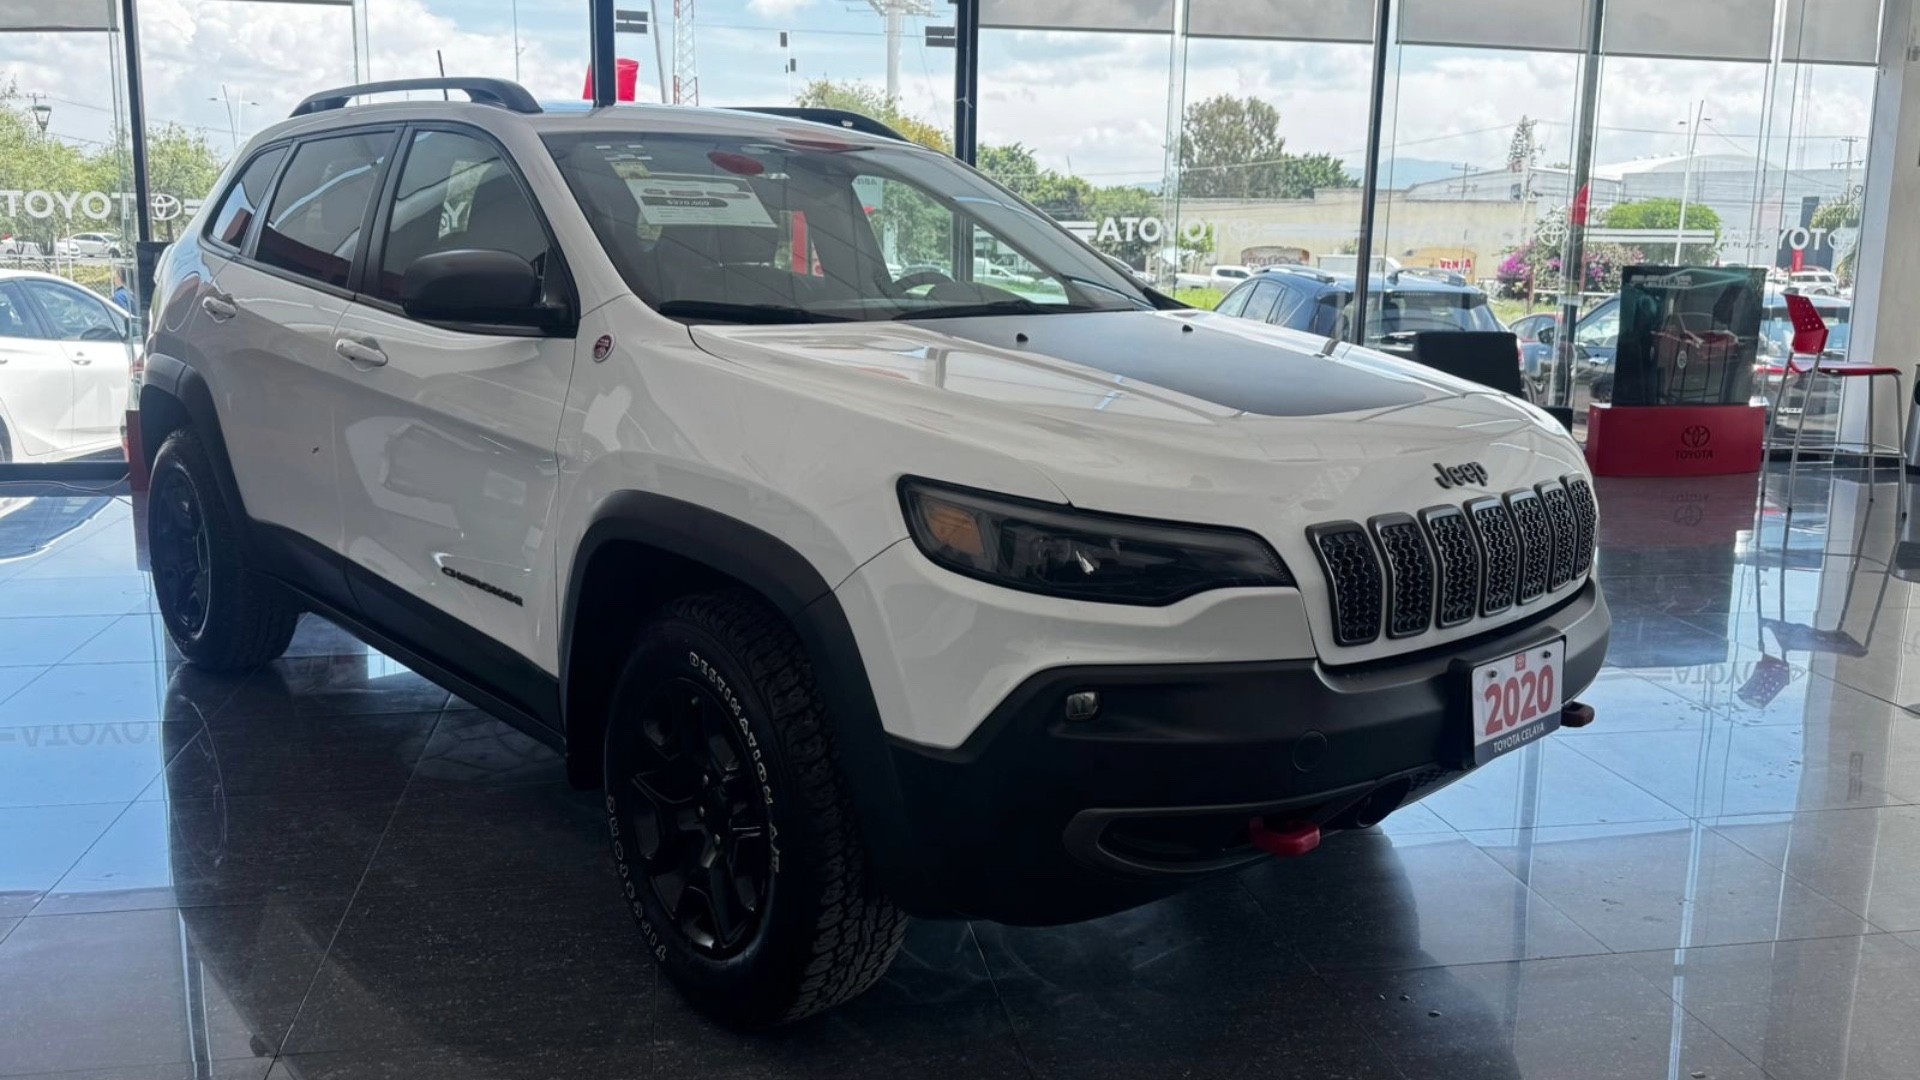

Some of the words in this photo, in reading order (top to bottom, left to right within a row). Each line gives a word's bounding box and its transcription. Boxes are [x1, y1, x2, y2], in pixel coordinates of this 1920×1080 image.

[1675, 450, 1713, 460] TOYOTA
[1433, 461, 1488, 489] Jeep
[1484, 664, 1554, 736] 2020
[689, 650, 774, 806] DESTINATION
[1493, 733, 1520, 753] TOYOTA
[1520, 722, 1545, 742] CELAYA
